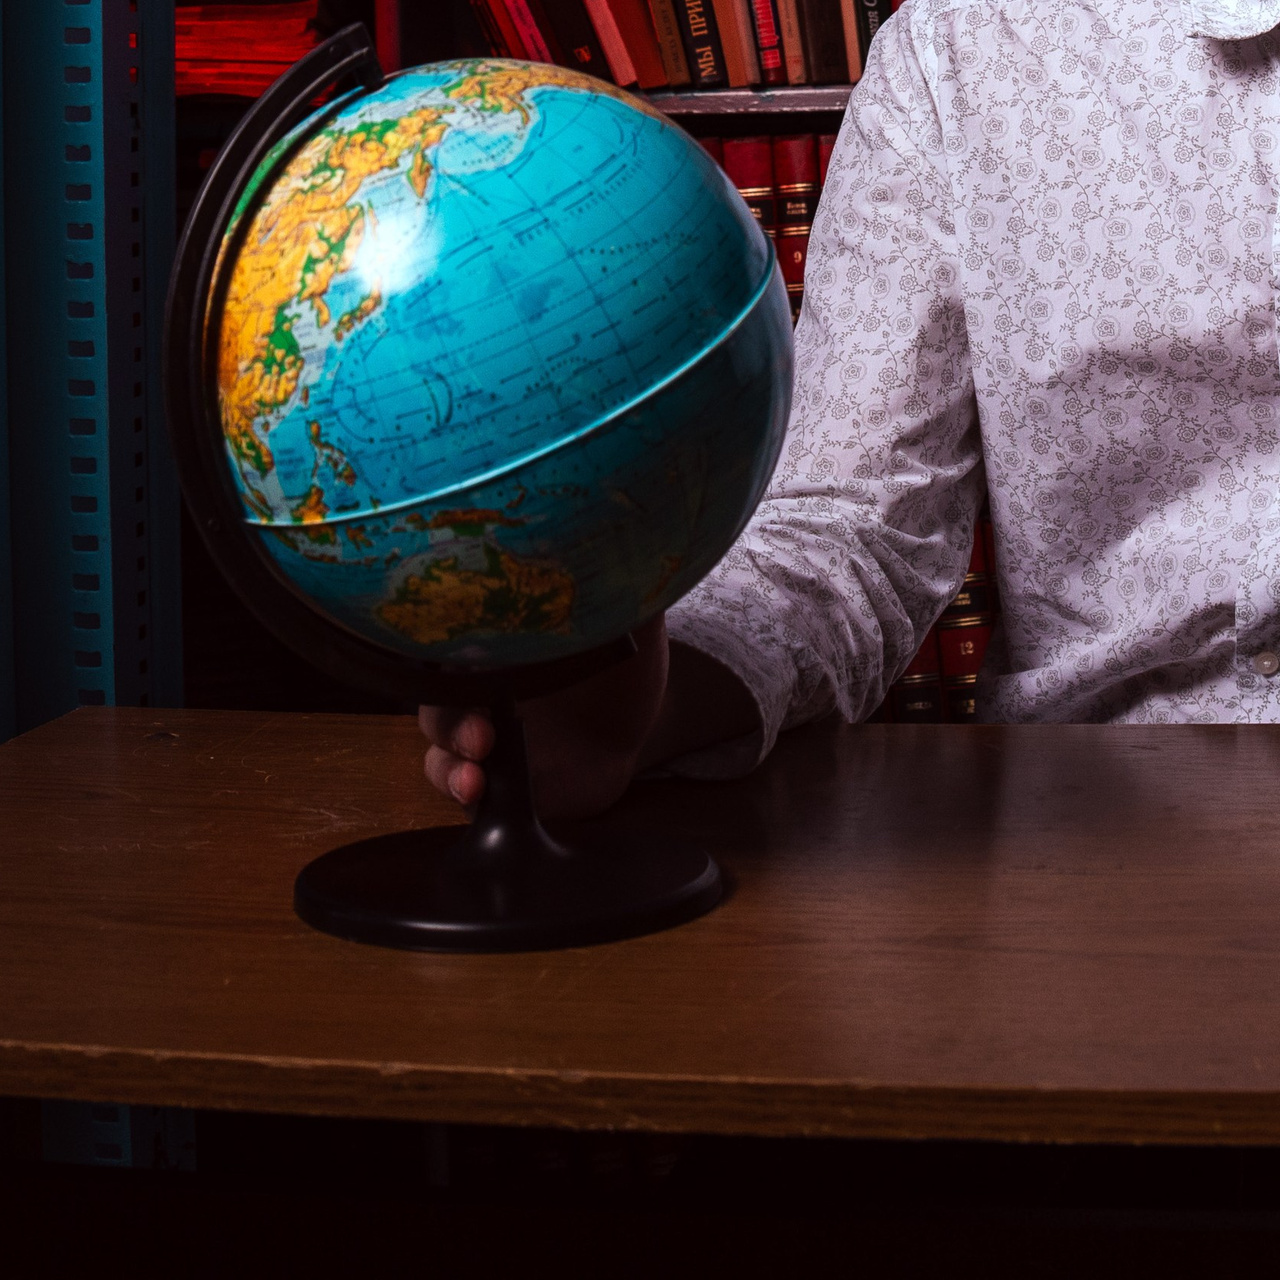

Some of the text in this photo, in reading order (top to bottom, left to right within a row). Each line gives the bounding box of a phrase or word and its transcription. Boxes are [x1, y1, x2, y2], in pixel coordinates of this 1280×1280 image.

[696, 45, 718, 77] МЫ
[793, 250, 802, 264] 9
[960, 640, 974, 655] 12
